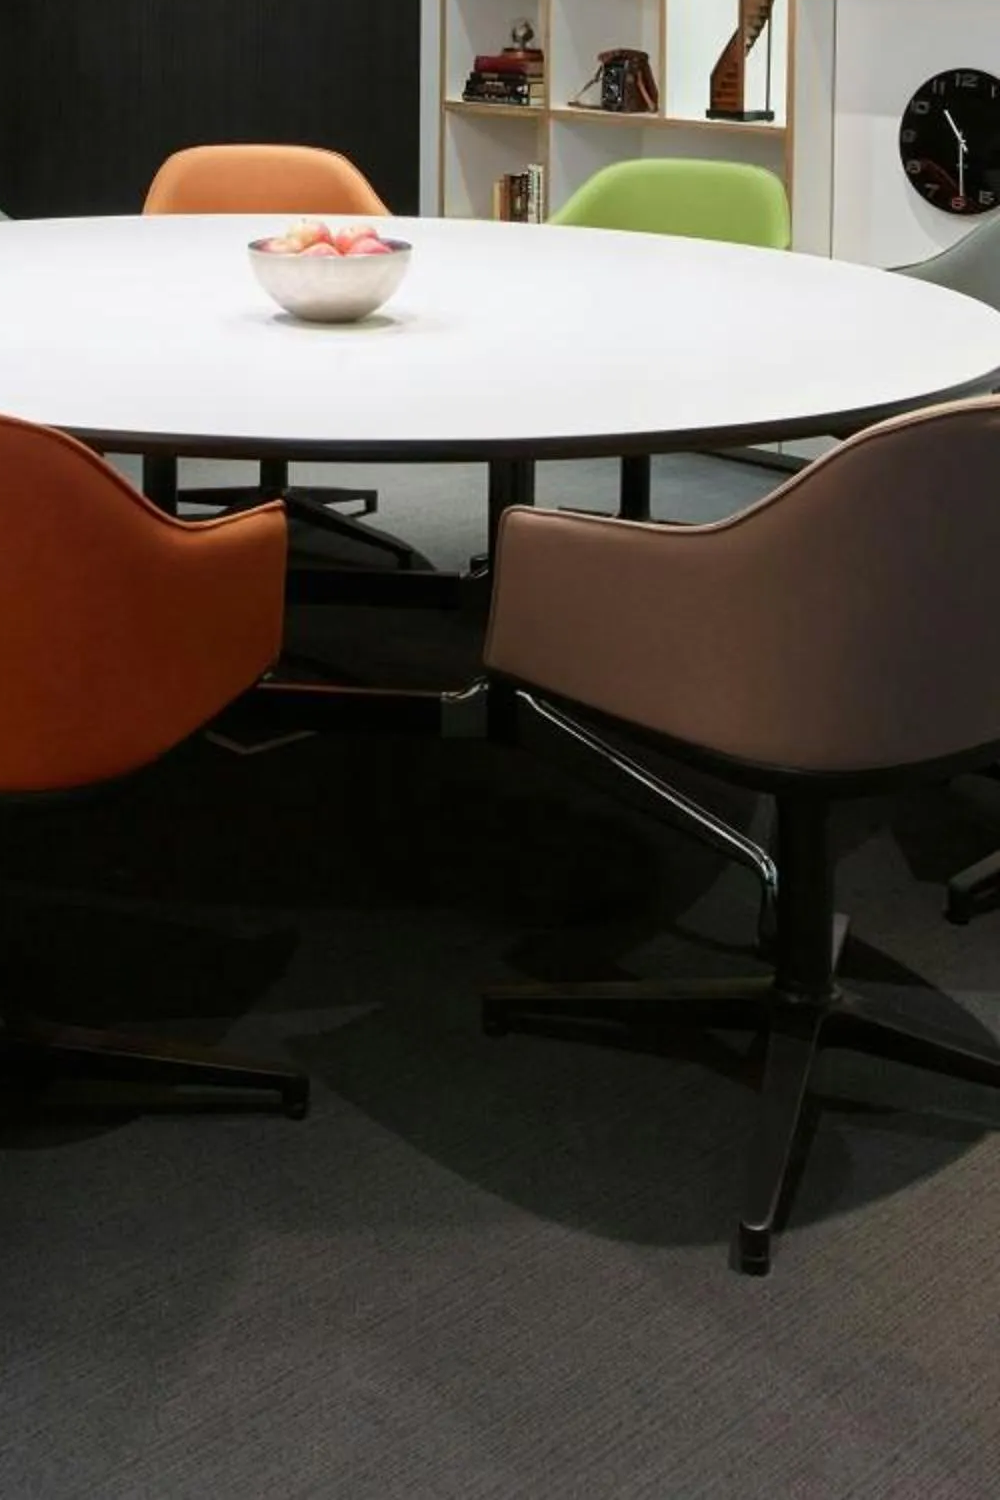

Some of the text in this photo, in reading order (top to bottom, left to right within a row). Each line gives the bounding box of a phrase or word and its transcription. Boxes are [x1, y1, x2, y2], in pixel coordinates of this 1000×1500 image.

[932, 79, 946, 95] 11
[955, 72, 978, 88] 12
[924, 183, 940, 199] 7
